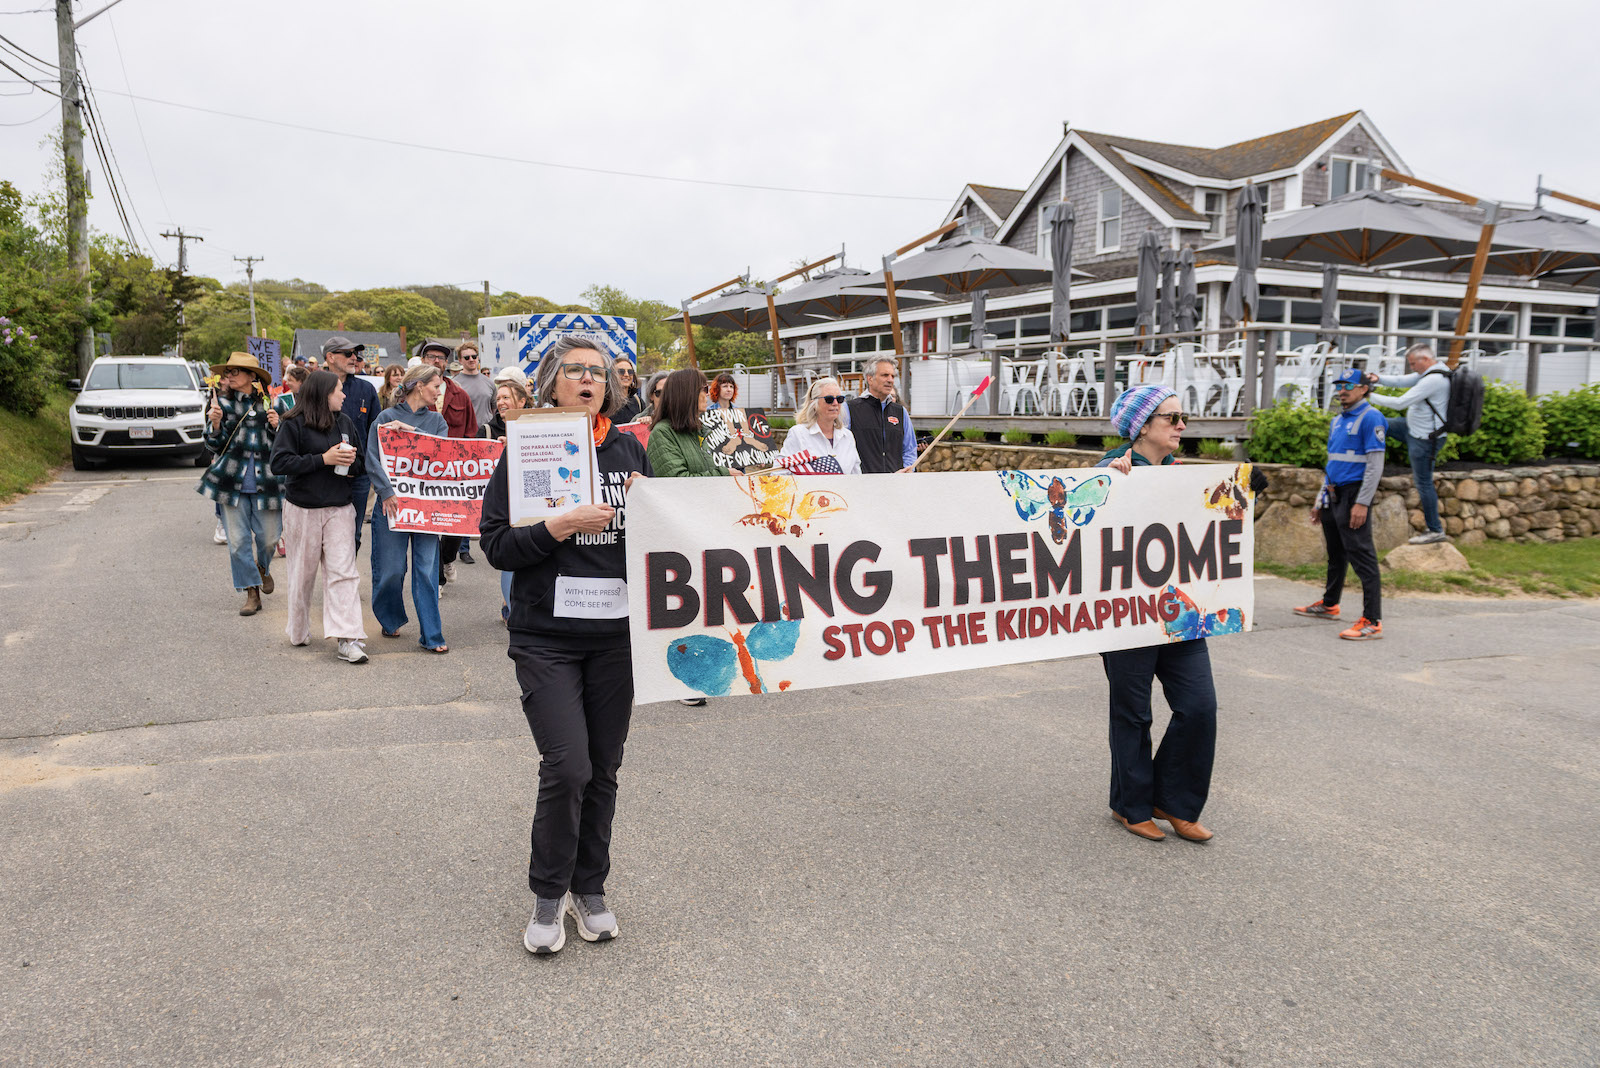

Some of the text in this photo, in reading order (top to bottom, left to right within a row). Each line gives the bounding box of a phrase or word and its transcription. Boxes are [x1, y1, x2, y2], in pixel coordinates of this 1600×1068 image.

[250, 340, 274, 354] WE
[698, 408, 746, 428] KEEP YOUR
[384, 454, 500, 478] EDUCATOR
[713, 452, 734, 468] OFF
[735, 450, 755, 466] OUR
[608, 472, 628, 484] MY
[420, 481, 486, 499] Immigr
[601, 485, 626, 506] IN
[576, 532, 618, 545] HOODIE
[646, 519, 1243, 630] BRING THEM HOME
[600, 587, 621, 596] PRESS?
[823, 592, 1181, 661] STOP THE KIDNAPPING
